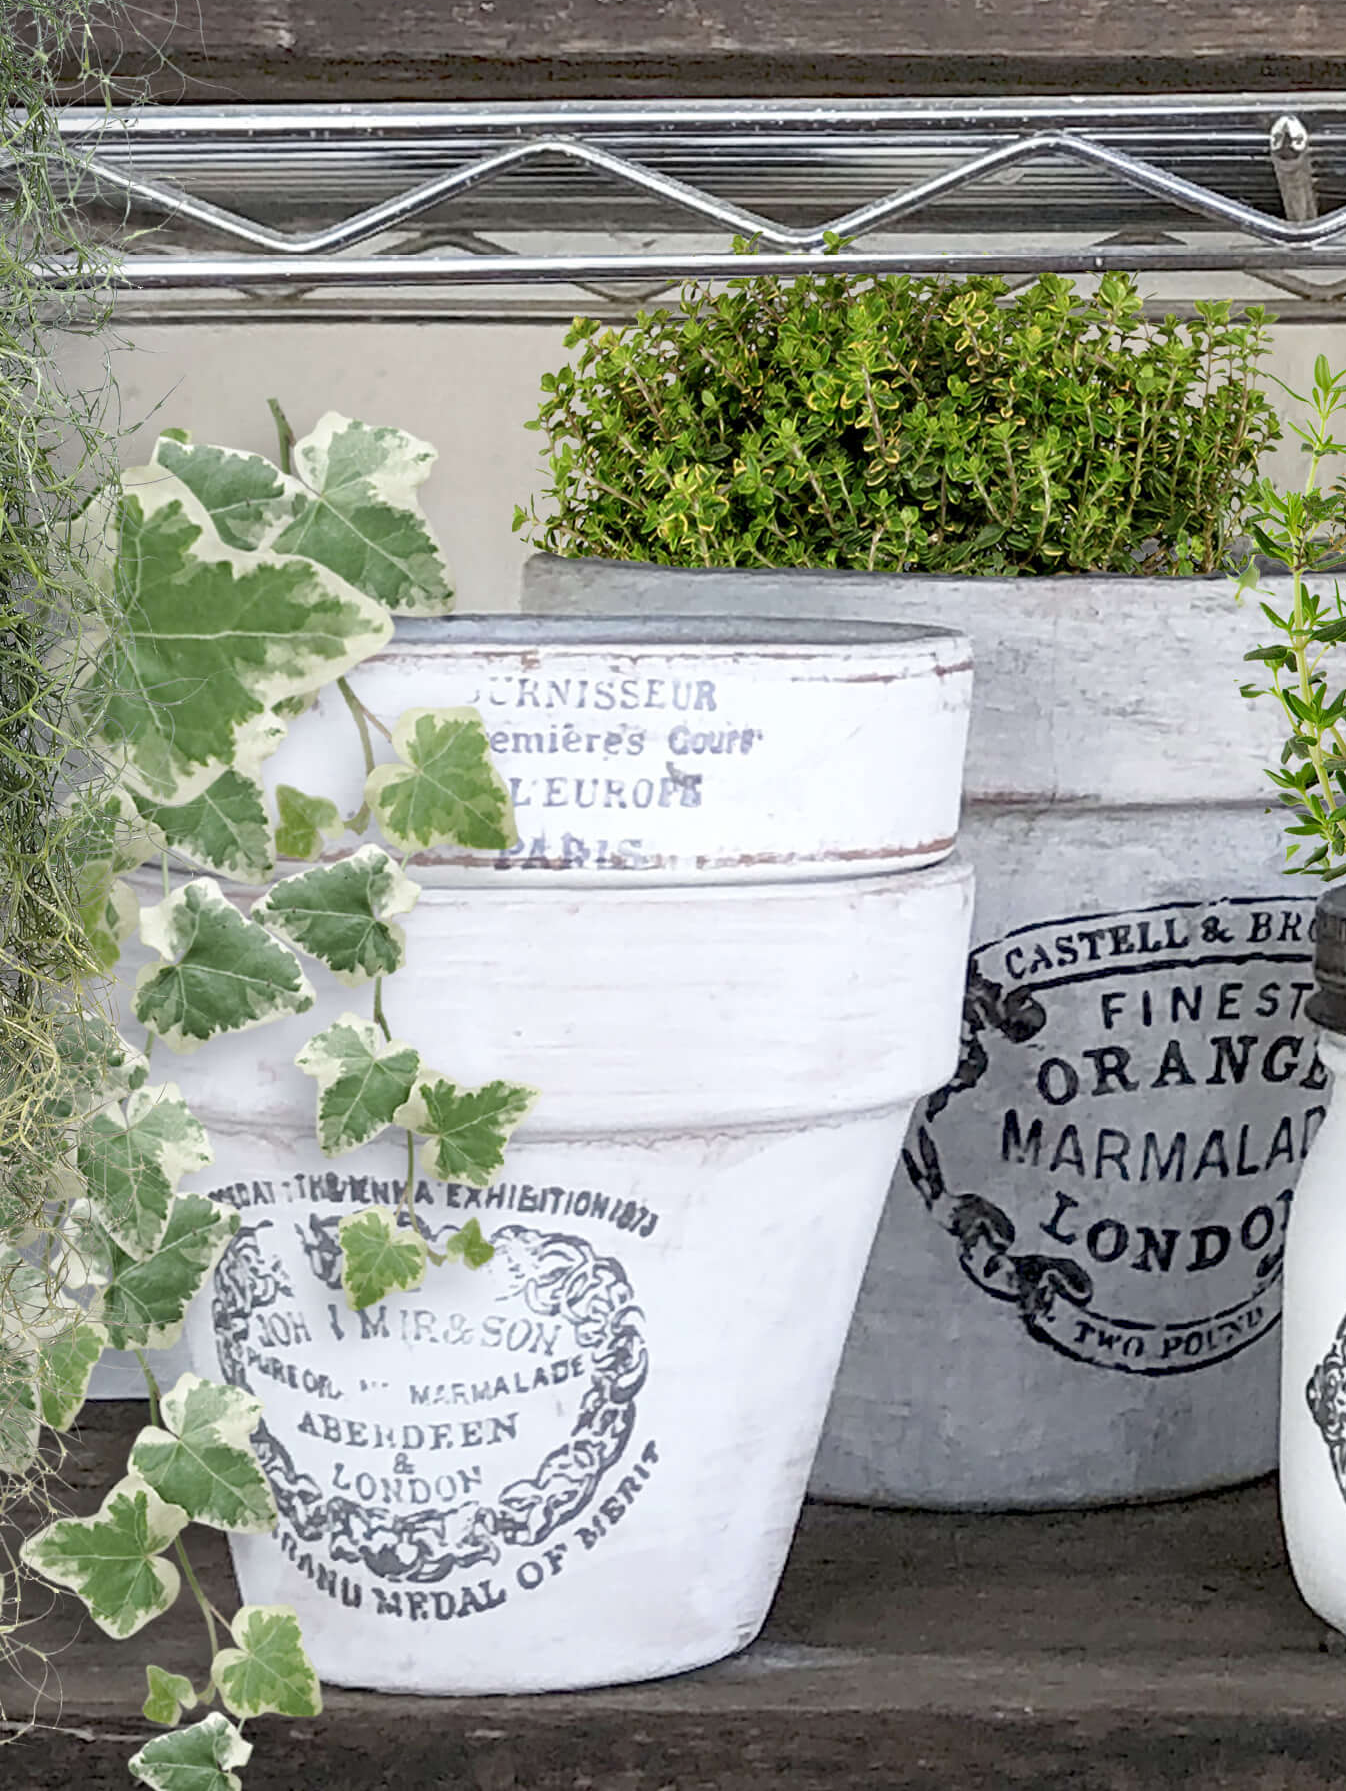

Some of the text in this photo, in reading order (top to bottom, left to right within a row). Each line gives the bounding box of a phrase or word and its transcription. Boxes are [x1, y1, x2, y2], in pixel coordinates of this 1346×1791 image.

[1003, 917, 1190, 980] CASTELL
[1200, 915, 1235, 944] &
[1100, 981, 1315, 1029] FINEST
[332, 1462, 483, 1504] LONDON
[392, 1452, 415, 1475] &
[515, 1542, 568, 1591] OF
[573, 1439, 661, 1552] MERIT
